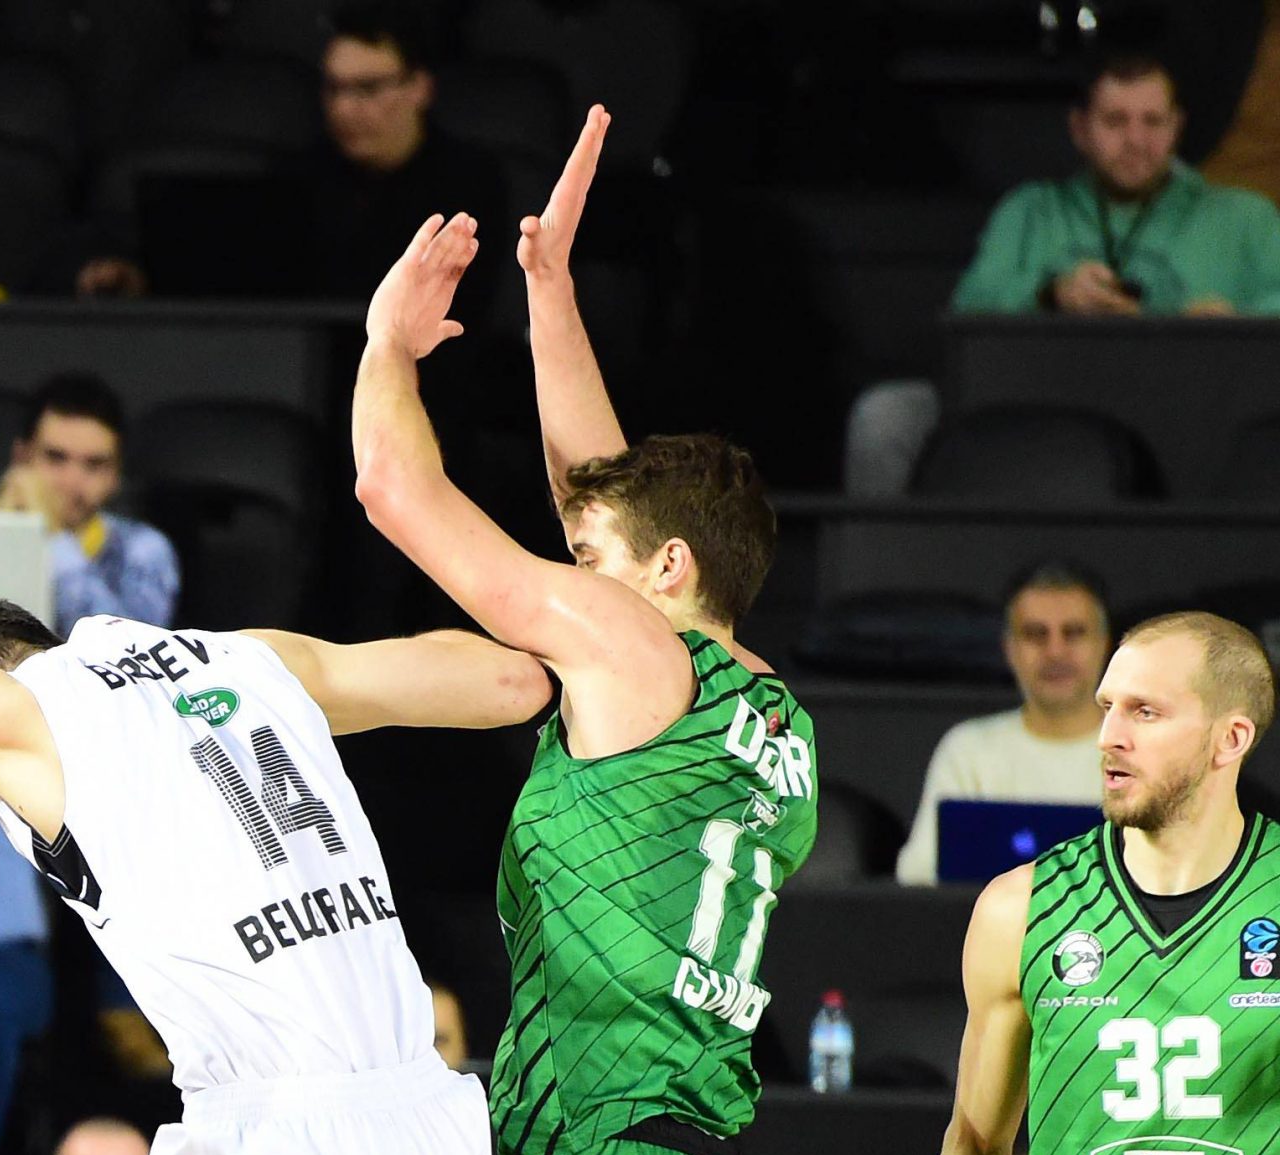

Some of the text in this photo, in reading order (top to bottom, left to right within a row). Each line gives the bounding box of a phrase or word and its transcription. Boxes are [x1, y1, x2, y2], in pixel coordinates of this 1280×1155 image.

[190, 725, 348, 871] 14
[687, 818, 777, 982] 11
[1097, 1015, 1223, 1122] 32
